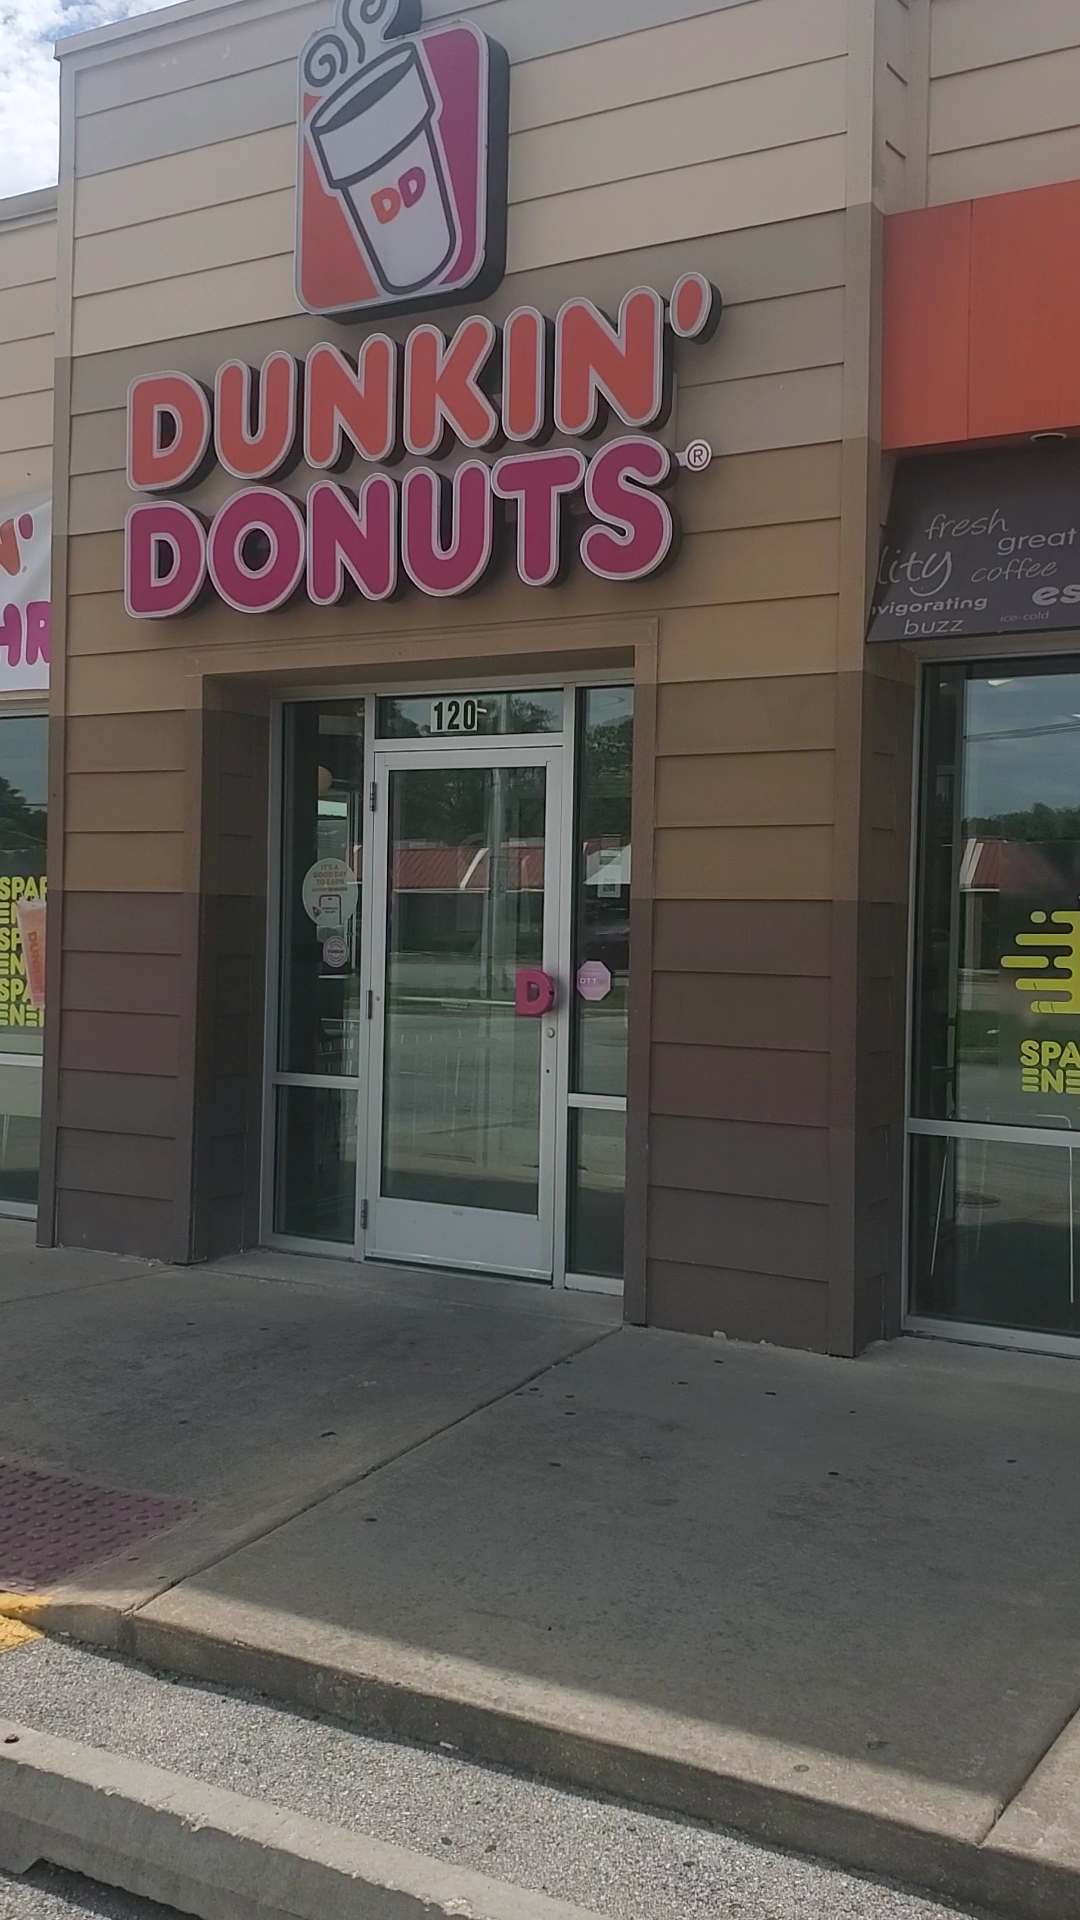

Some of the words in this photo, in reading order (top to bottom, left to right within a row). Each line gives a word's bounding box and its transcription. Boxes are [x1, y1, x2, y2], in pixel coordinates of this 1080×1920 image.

[370, 167, 427, 224] DD
[127, 273, 712, 491] DUNKIN'
[125, 436, 673, 619] DONUTS
[925, 508, 1009, 540] fresh
[997, 528, 1077, 555] great
[970, 558, 1058, 583] coffee
[1032, 584, 1080, 606] es
[904, 618, 964, 636] buzz
[1000, 611, 1050, 623] ice-cold
[434, 700, 475, 730] 120
[516, 969, 554, 1016] D
[1020, 1040, 1080, 1067] SPA
[1021, 1068, 1080, 1093] ENE
